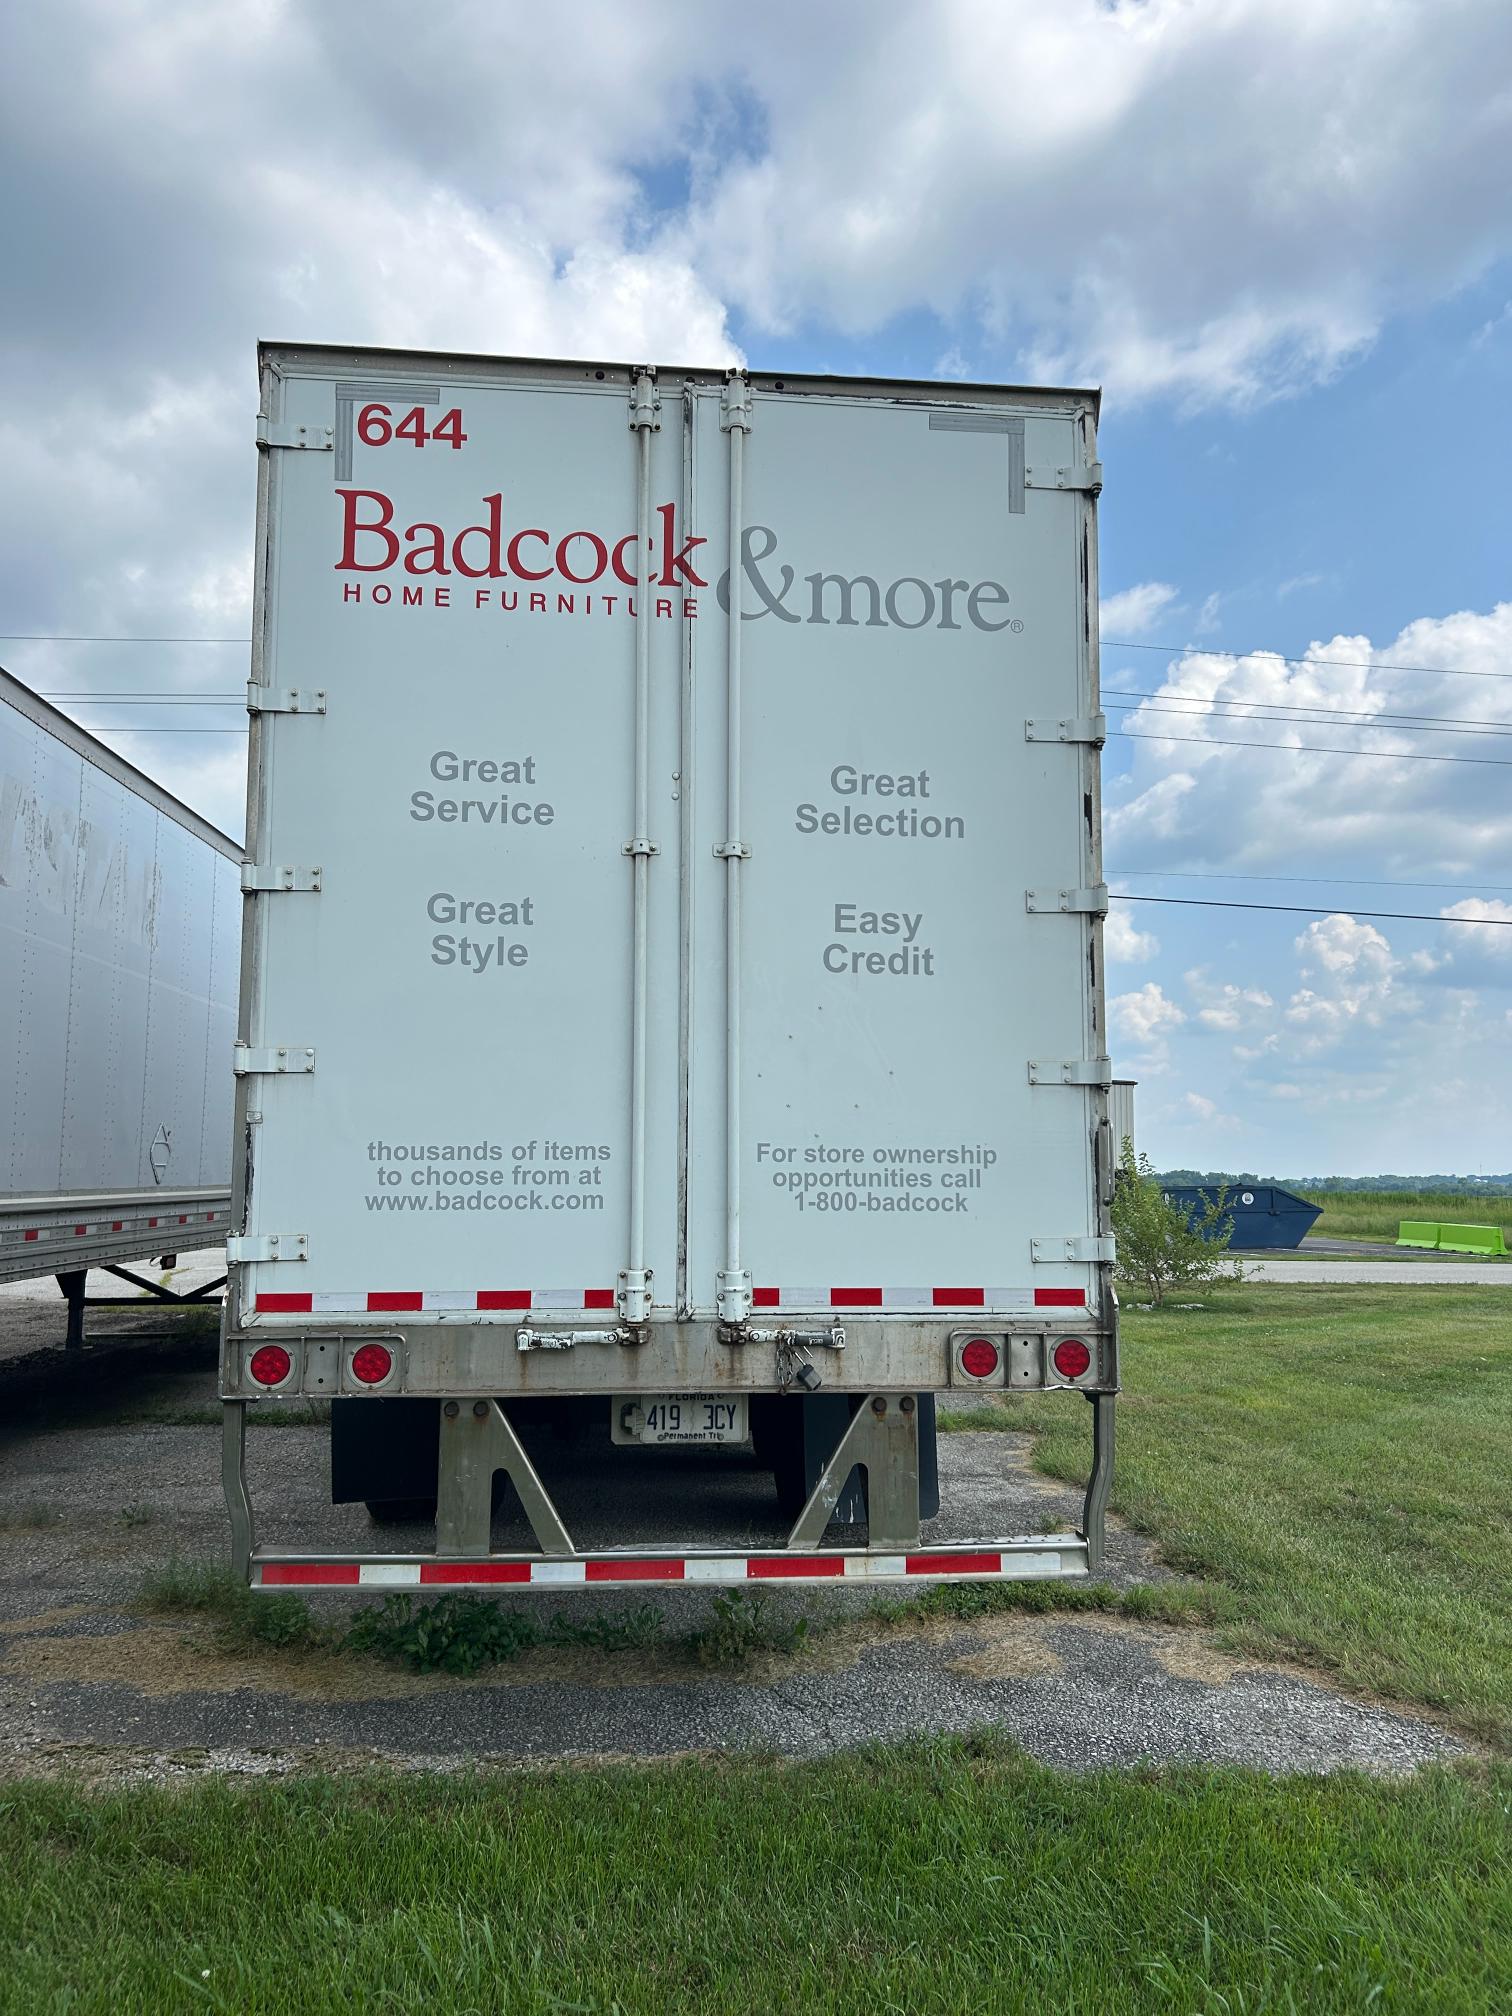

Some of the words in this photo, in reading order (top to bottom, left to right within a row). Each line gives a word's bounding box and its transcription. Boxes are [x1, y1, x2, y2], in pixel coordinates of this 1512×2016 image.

[357, 403, 468, 449] 644
[334, 488, 709, 587] Badcock
[343, 583, 452, 608] HOME
[475, 589, 699, 619] FURNITURE
[430, 750, 536, 784] Great
[830, 765, 930, 798] Great
[410, 791, 555, 826] Service
[795, 803, 965, 839] Selection
[426, 892, 534, 926] Great
[834, 903, 923, 943] Easy
[431, 934, 529, 974] Style
[823, 943, 935, 976] Credit
[367, 1140, 503, 1162] thousands
[511, 1140, 538, 1161] of
[544, 1140, 612, 1161] items
[756, 1143, 797, 1163] For
[804, 1143, 865, 1164] store
[873, 1144, 997, 1169] ownership
[377, 1166, 402, 1186] to
[410, 1166, 504, 1186] choose
[512, 1165, 570, 1185] from
[578, 1166, 602, 1185] at
[772, 1168, 933, 1192] opportunities
[940, 1169, 982, 1188] call
[364, 1190, 604, 1211] www.badcock.com
[794, 1191, 969, 1212] 1-800-badcock
[647, 1405, 681, 1431] 419
[703, 1405, 737, 1430] 3CY
